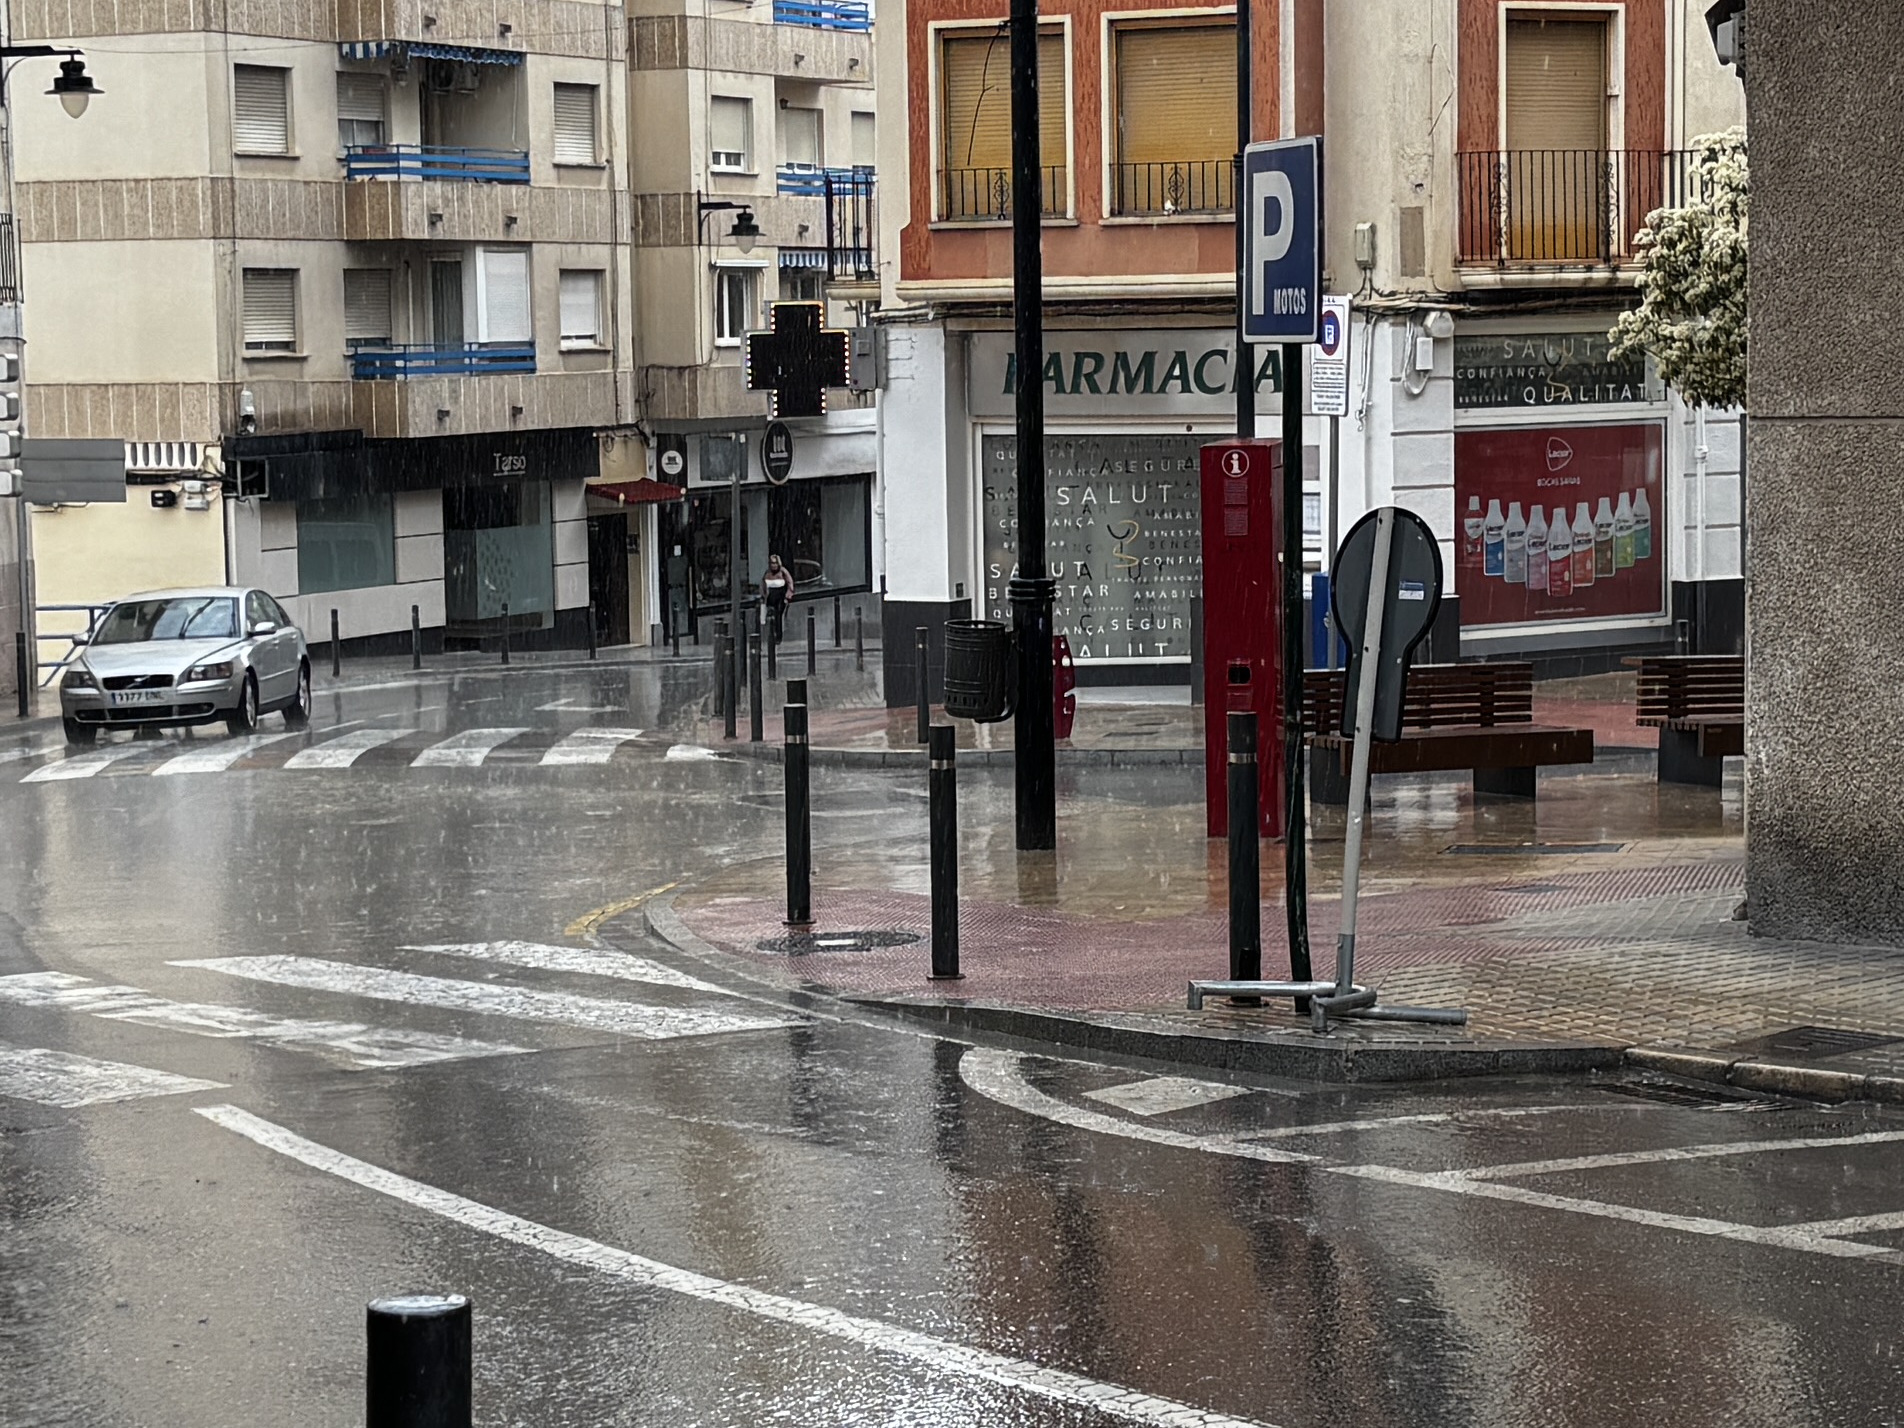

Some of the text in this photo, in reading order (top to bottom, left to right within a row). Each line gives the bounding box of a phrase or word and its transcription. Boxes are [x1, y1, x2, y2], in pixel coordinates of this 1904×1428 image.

[1252, 170, 1295, 316] P
[1273, 288, 1307, 315] MOTOS
[1002, 348, 1284, 395] ARMACA
[1056, 484, 1173, 506] SALUT
[990, 560, 1085, 579] SAUT
